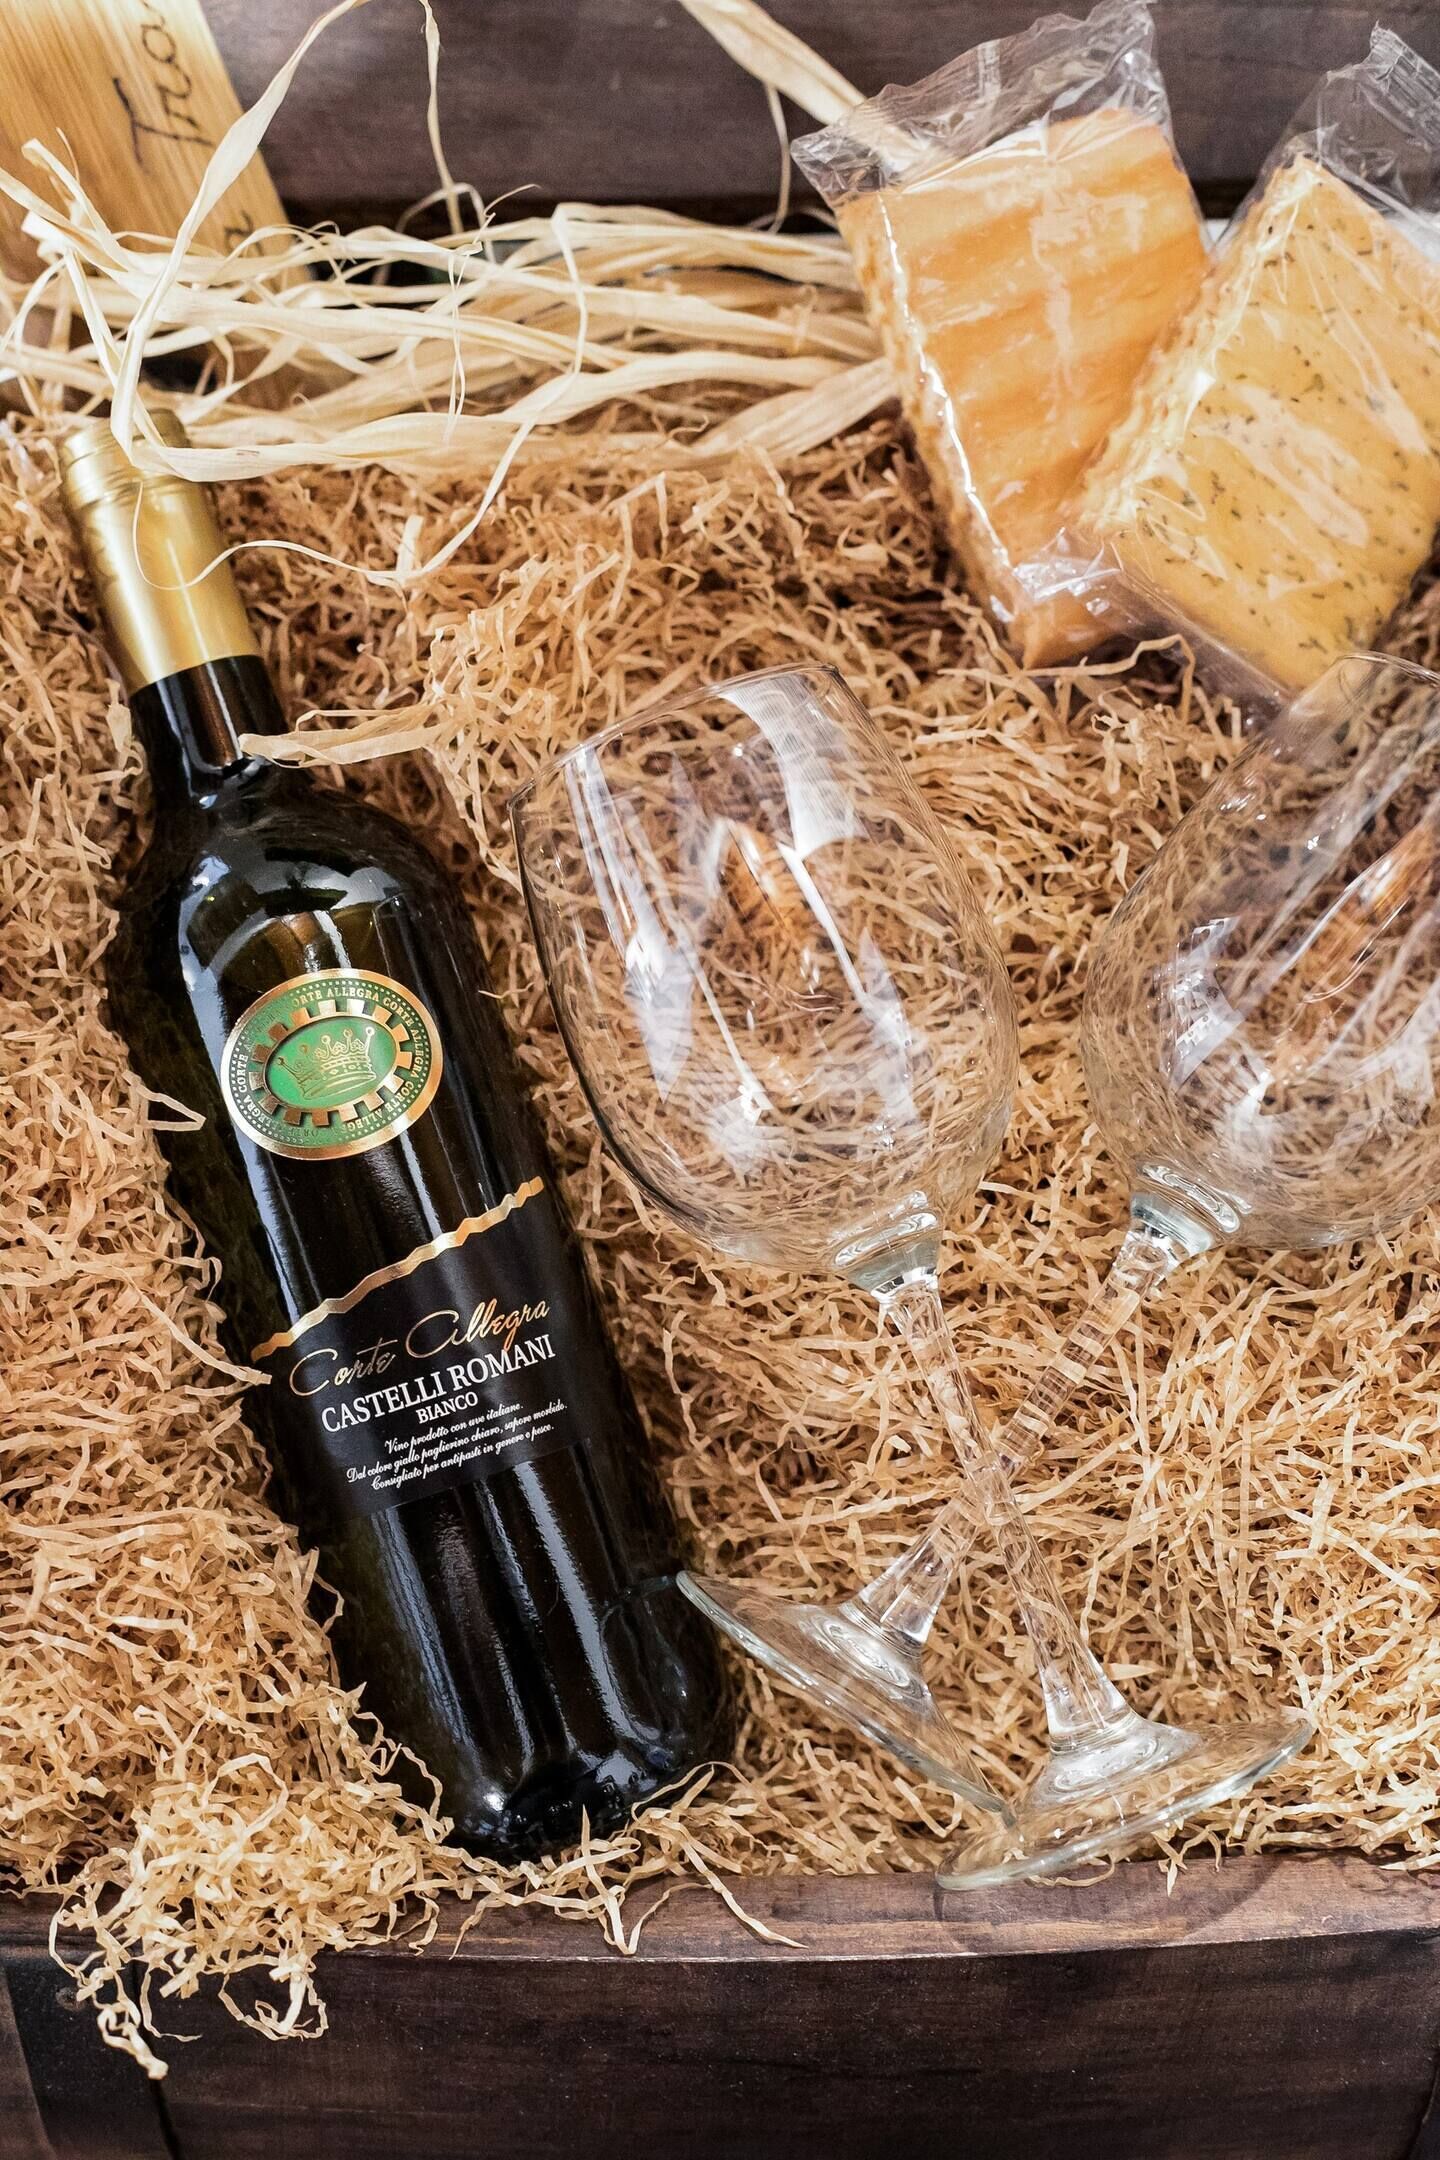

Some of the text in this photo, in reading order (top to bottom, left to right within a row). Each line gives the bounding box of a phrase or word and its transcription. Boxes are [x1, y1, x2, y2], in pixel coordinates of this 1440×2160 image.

[112, 0, 213, 170] Tra
[327, 986, 380, 1002] ALLEGRA
[382, 996, 415, 1028] CORTE
[236, 1053, 249, 1093] CORTE
[410, 1028, 425, 1079] ALLEGRA
[384, 1080, 415, 1113] CORTE
[289, 1337, 399, 1397] Corte
[321, 1333, 557, 1433] CASTELLI ROMANI
[384, 1403, 524, 1454] Vino prodotto con uve italiane.
[415, 1391, 479, 1424] BIANCO
[346, 1398, 567, 1483] Dal colore giallo paglierino chiaro, sapore morbido.
[371, 1423, 555, 1490] Consigliato per antipasti in genere e pesce.
